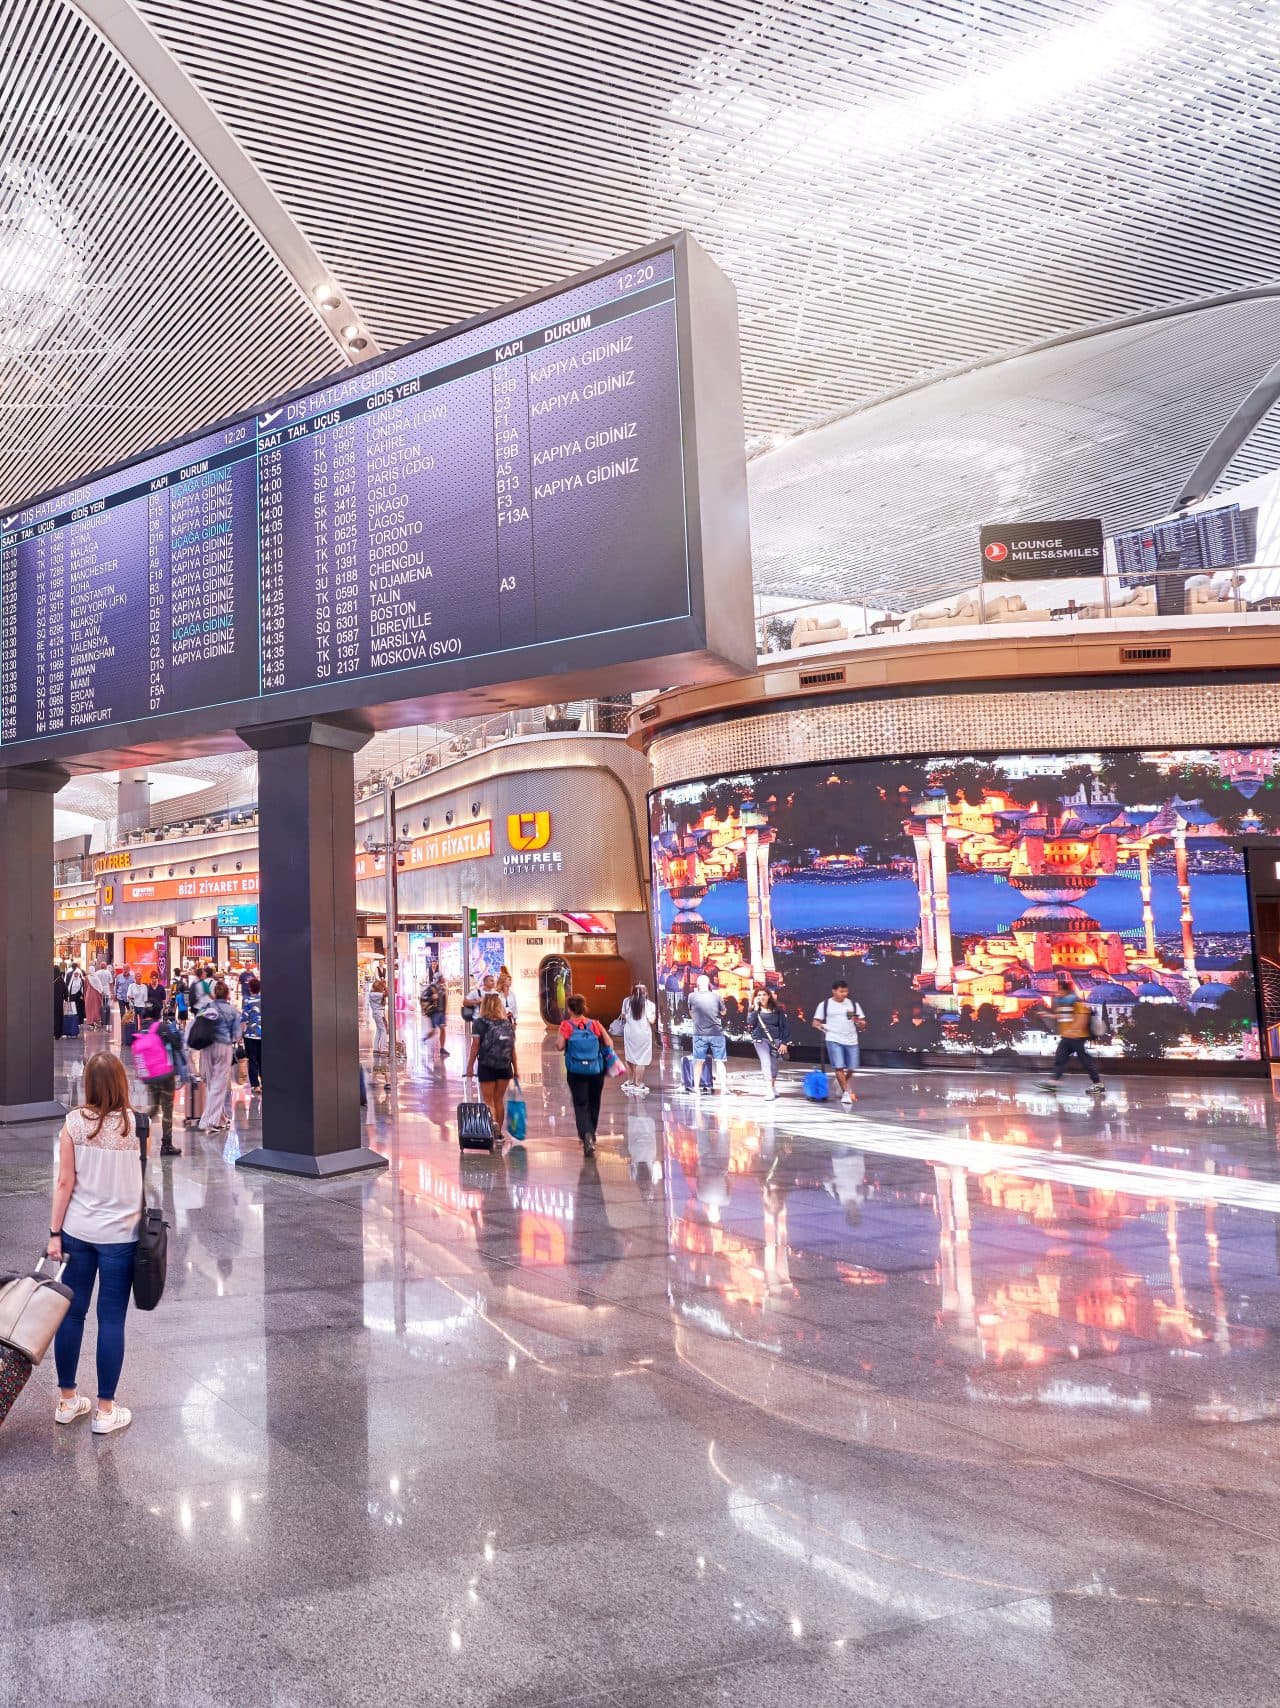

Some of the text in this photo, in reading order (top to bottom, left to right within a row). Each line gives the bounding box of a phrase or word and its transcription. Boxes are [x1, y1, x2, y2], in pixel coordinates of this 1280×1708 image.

[617, 265, 653, 291] 12:20
[258, 314, 590, 450] SAAT TAH. UÇUŞ GİDİŞ YERİ KAPI DURUM
[260, 463, 281, 481] 13:55
[314, 447, 326, 461] TK
[367, 416, 411, 443] LONDRA
[530, 355, 577, 383] KAPIYA
[581, 333, 633, 366] GİDİNİZ
[287, 401, 305, 423] DIŞ
[310, 380, 358, 410] HATLAR
[224, 426, 245, 445] 12:20
[259, 449, 281, 467] 13:55
[313, 433, 325, 447] TU
[366, 404, 402, 428] TUNUS
[260, 491, 282, 508] 14:00
[313, 475, 327, 490] SQ
[367, 444, 420, 472] HOUSTON
[494, 413, 508, 429] F1
[531, 388, 578, 416] KAPIYA
[582, 367, 635, 399] GİDİNİZ
[260, 477, 281, 494] 14:00
[313, 461, 327, 476] SQ
[494, 396, 510, 413] C3
[260, 505, 282, 522] 14:00
[313, 490, 325, 504] 6E
[333, 480, 356, 498] 4047
[402, 454, 434, 478] (CDG)
[495, 426, 518, 445] F9A
[260, 533, 282, 549] 14:10
[315, 518, 327, 532] TK
[334, 510, 356, 527] 0005
[496, 461, 511, 477] A5
[533, 439, 580, 466] KAPIYA
[584, 420, 637, 450] GİDİNİZ
[260, 442, 518, 535] 14:05 SK 3412 OSLO F9B
[2, 533, 17, 547] SAAT
[38, 518, 54, 535] UÇUŞ
[150, 476, 167, 491] KAPI
[180, 460, 208, 480] DURUM
[21, 509, 33, 526] DIŞ
[35, 495, 65, 518] HATLAR
[261, 455, 638, 577] 14:15 TK 0017 TORONTO F3 KAPIYA GİDİNİZ
[261, 475, 519, 563] 14:10 TK 0625 LAGOS B13
[261, 506, 529, 591] 14:15 TK 1391 BORDO F13A
[1011, 539, 1063, 550] LOUNGE
[1012, 548, 1099, 560] MILES&SMILES
[261, 589, 283, 605] 14:25
[315, 577, 327, 590] 3U
[369, 551, 423, 576] CHENGDU
[261, 565, 432, 619] 14:25 TK 0590 N DJAMENA
[261, 586, 400, 633] 14:30 SQ 6281 TALİN
[261, 577, 515, 647] 14:35 SQ 6301 BOSTON A3
[172, 649, 201, 666] KAPIYA
[203, 639, 234, 659] GİDİNİZ
[262, 610, 431, 661] 14:35 TK 0587 LİBREVİLLE
[262, 627, 426, 675] 14:35 TK 1367 MARSİLYA
[262, 638, 461, 689] 14:40 SU 2137 MOSKOVA (SVO)
[70, 687, 94, 701] ERCAN
[70, 699, 93, 713] SOFYA
[70, 708, 111, 725] FRANKFURT
[110, 852, 130, 868] FREE
[411, 847, 423, 864] EN
[503, 852, 562, 865] UNIFREE
[178, 880, 196, 895] BİZİ
[199, 880, 239, 894] ZİYARET
